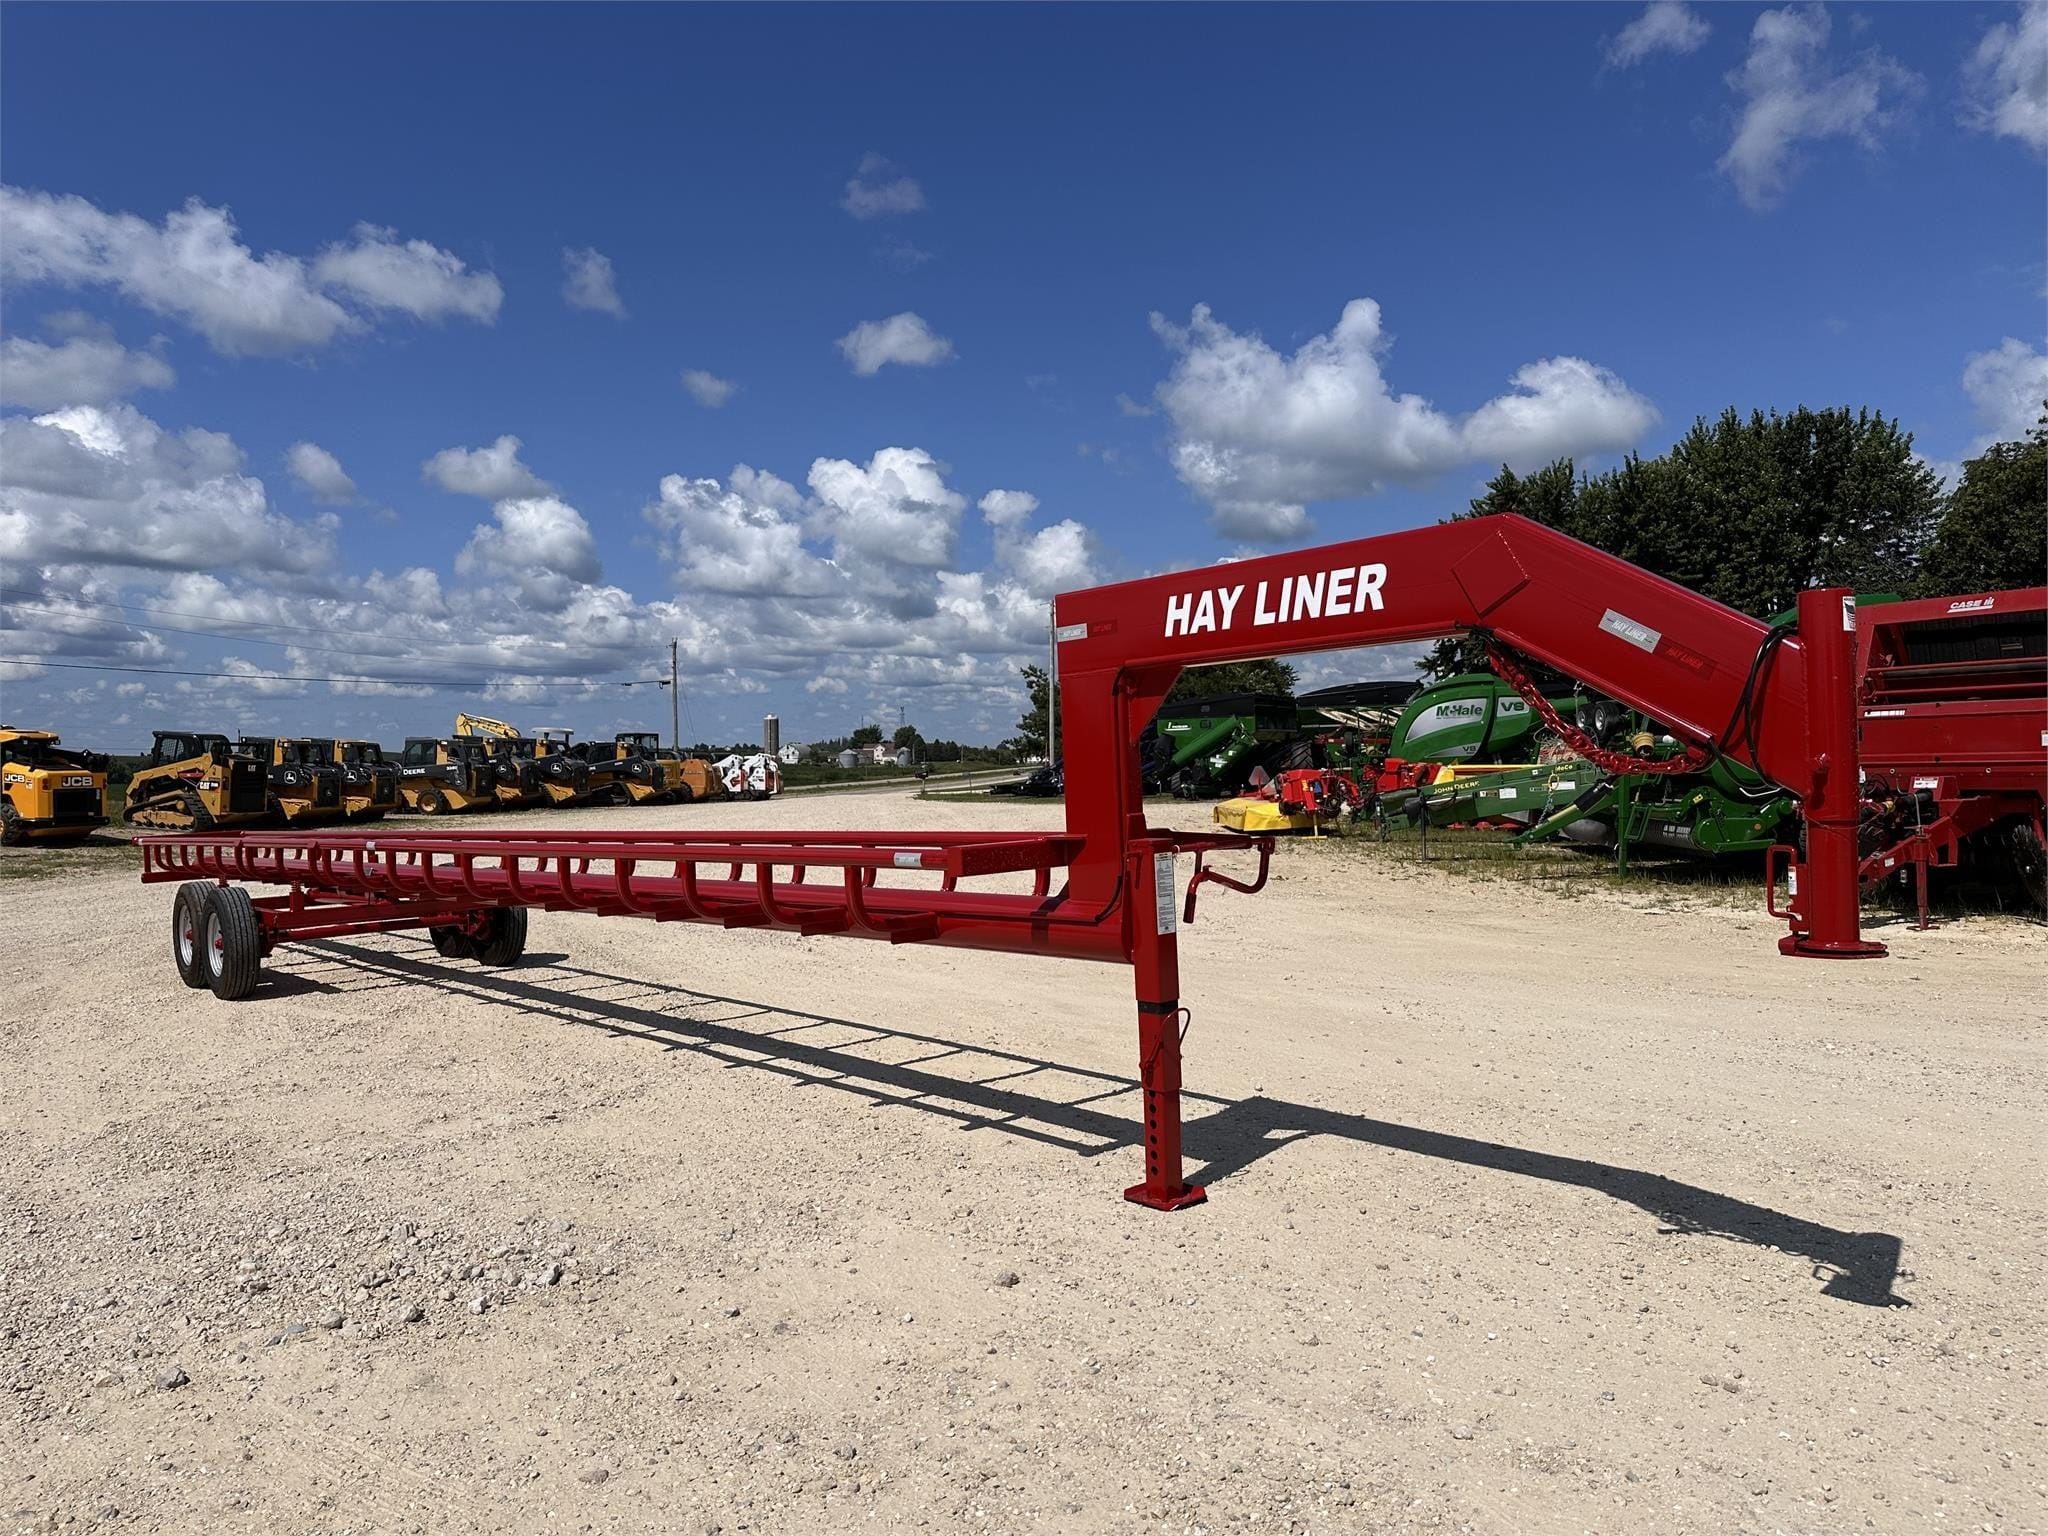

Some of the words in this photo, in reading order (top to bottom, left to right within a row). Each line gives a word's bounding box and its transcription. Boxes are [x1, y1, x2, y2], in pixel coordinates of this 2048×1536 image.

[1164, 585, 1246, 638] HAY
[1253, 563, 1388, 626] LINER
[1950, 600, 1982, 609] CASE
[1611, 620, 1628, 632] HAY
[1625, 626, 1648, 642] LINER
[1435, 704, 1483, 717] McHale
[1501, 701, 1525, 712] V8
[247, 764, 257, 772] CAT
[4, 774, 25, 782] JCB
[62, 776, 93, 787] JCB
[200, 781, 211, 790] CAT
[1433, 785, 1454, 794] JOHN
[1454, 780, 1480, 790] DEERE
